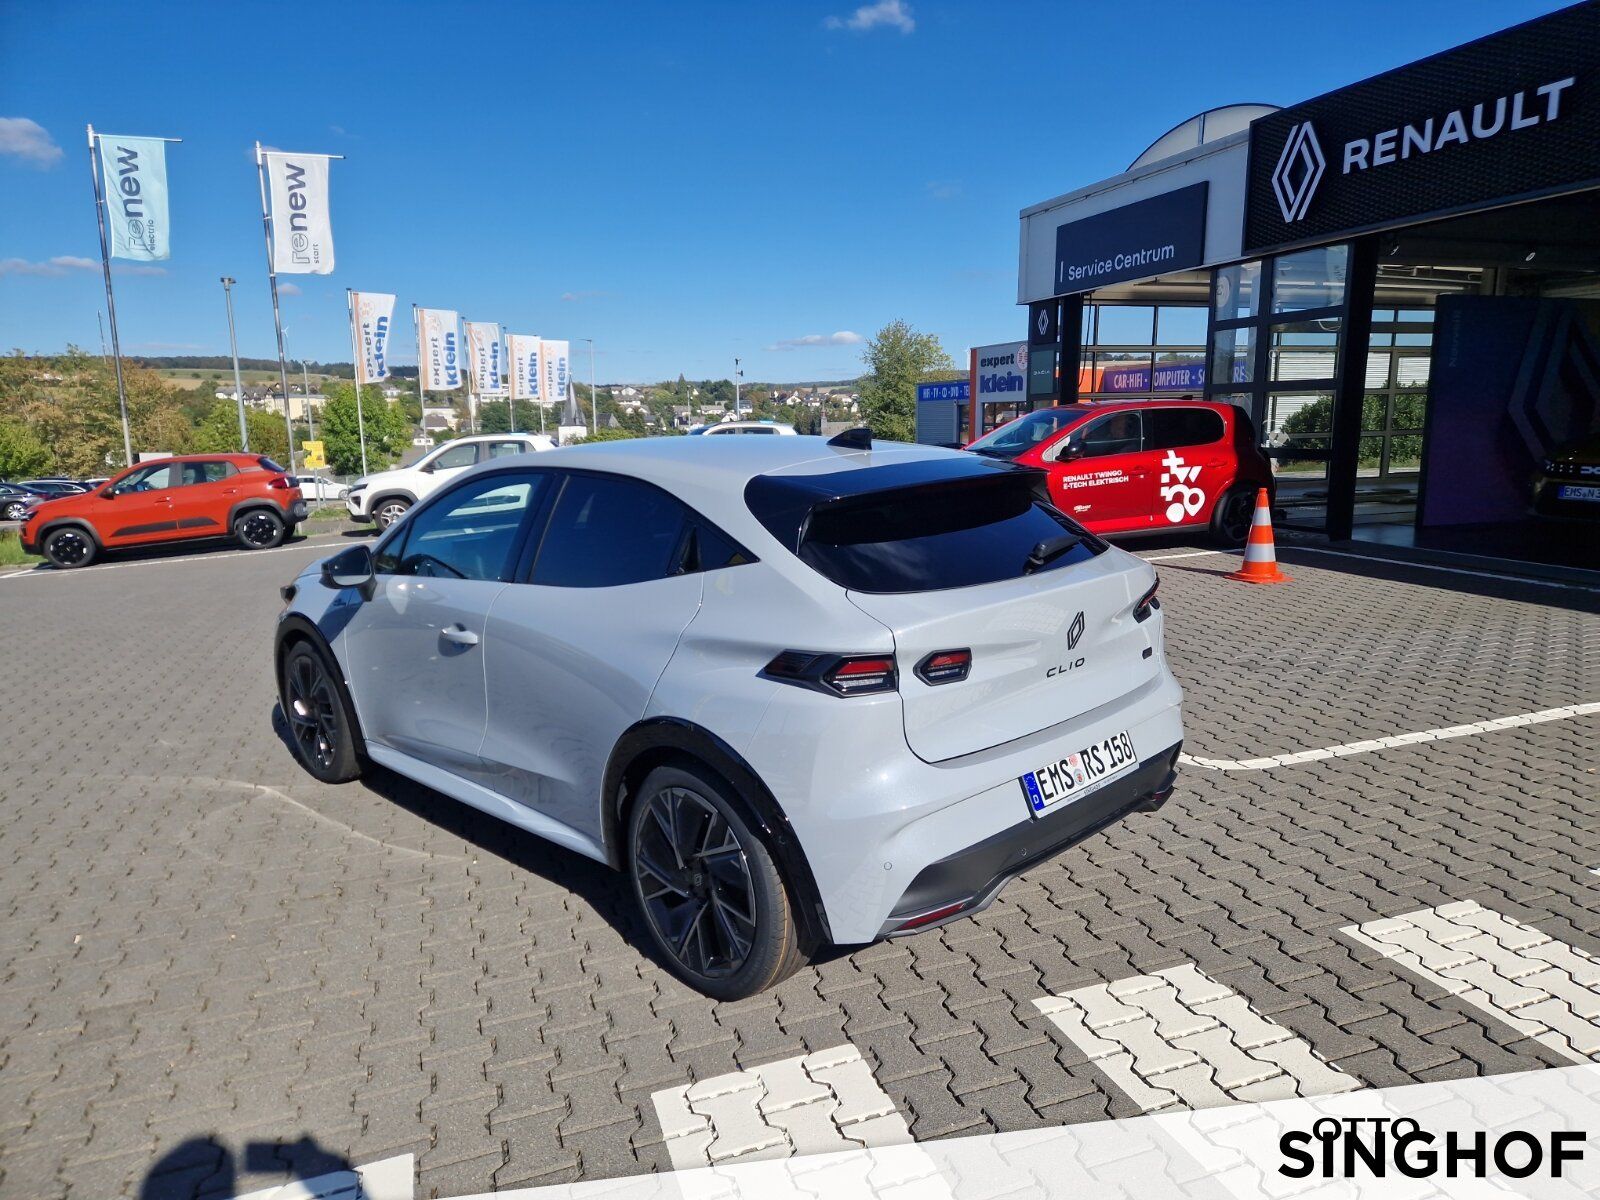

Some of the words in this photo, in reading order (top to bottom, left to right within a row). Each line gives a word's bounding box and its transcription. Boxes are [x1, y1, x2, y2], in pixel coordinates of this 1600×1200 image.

[1342, 76, 1576, 175] RENAULT
[116, 145, 145, 251] renew
[285, 162, 311, 265] renew
[312, 243, 320, 264] start
[1068, 258, 1113, 281] Service
[1114, 244, 1175, 271] Centrum
[374, 315, 389, 377] klein
[431, 337, 441, 386] expert
[442, 331, 458, 386] klein
[489, 341, 499, 389] klein
[980, 353, 1015, 367] expert
[528, 352, 538, 395] klein
[556, 357, 566, 397] klein
[979, 371, 1024, 393] klein
[1063, 473, 1093, 482] RENAULT
[1094, 469, 1122, 479] TWINGO
[1063, 481, 1088, 490] E-TECH
[1088, 475, 1129, 487] ELEKTRISCH
[1046, 657, 1085, 678] CLIO
[1036, 759, 1075, 801] EMS
[1080, 744, 1106, 780] RS
[1103, 732, 1133, 769] 158
